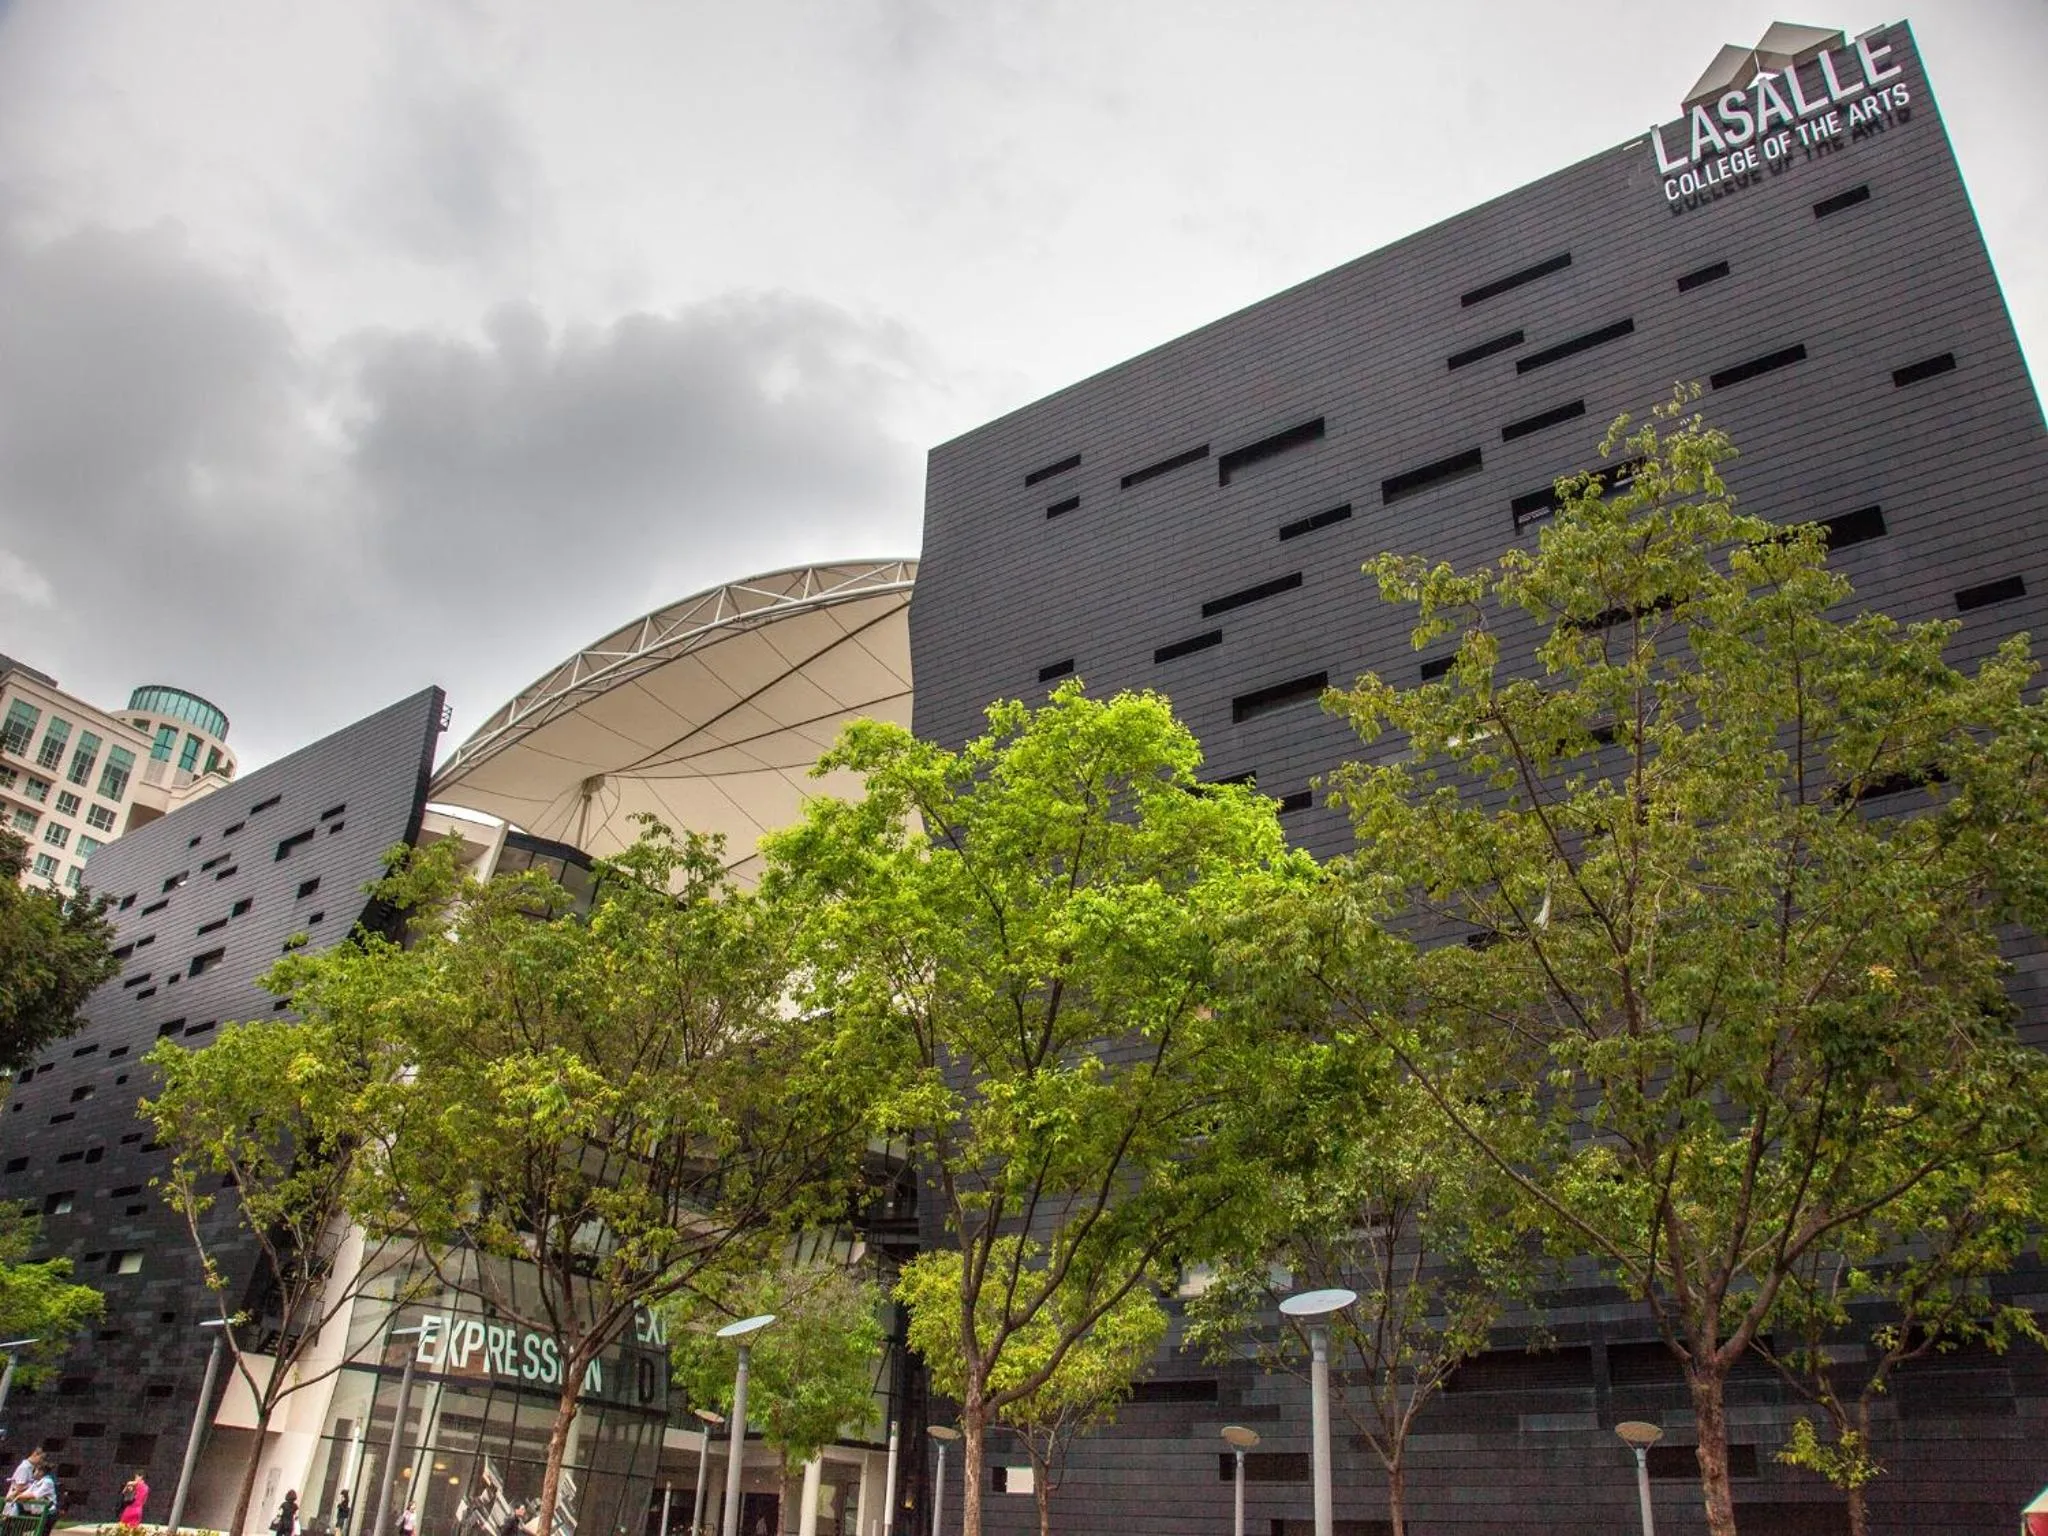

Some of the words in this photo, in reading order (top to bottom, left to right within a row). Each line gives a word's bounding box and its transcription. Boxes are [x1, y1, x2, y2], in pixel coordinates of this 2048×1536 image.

[1650, 36, 1901, 175] LASALLE
[1664, 144, 1760, 201] COLLEGE
[1763, 130, 1792, 159] OF
[1796, 110, 1842, 146] THE
[1849, 82, 1910, 127] ARTS
